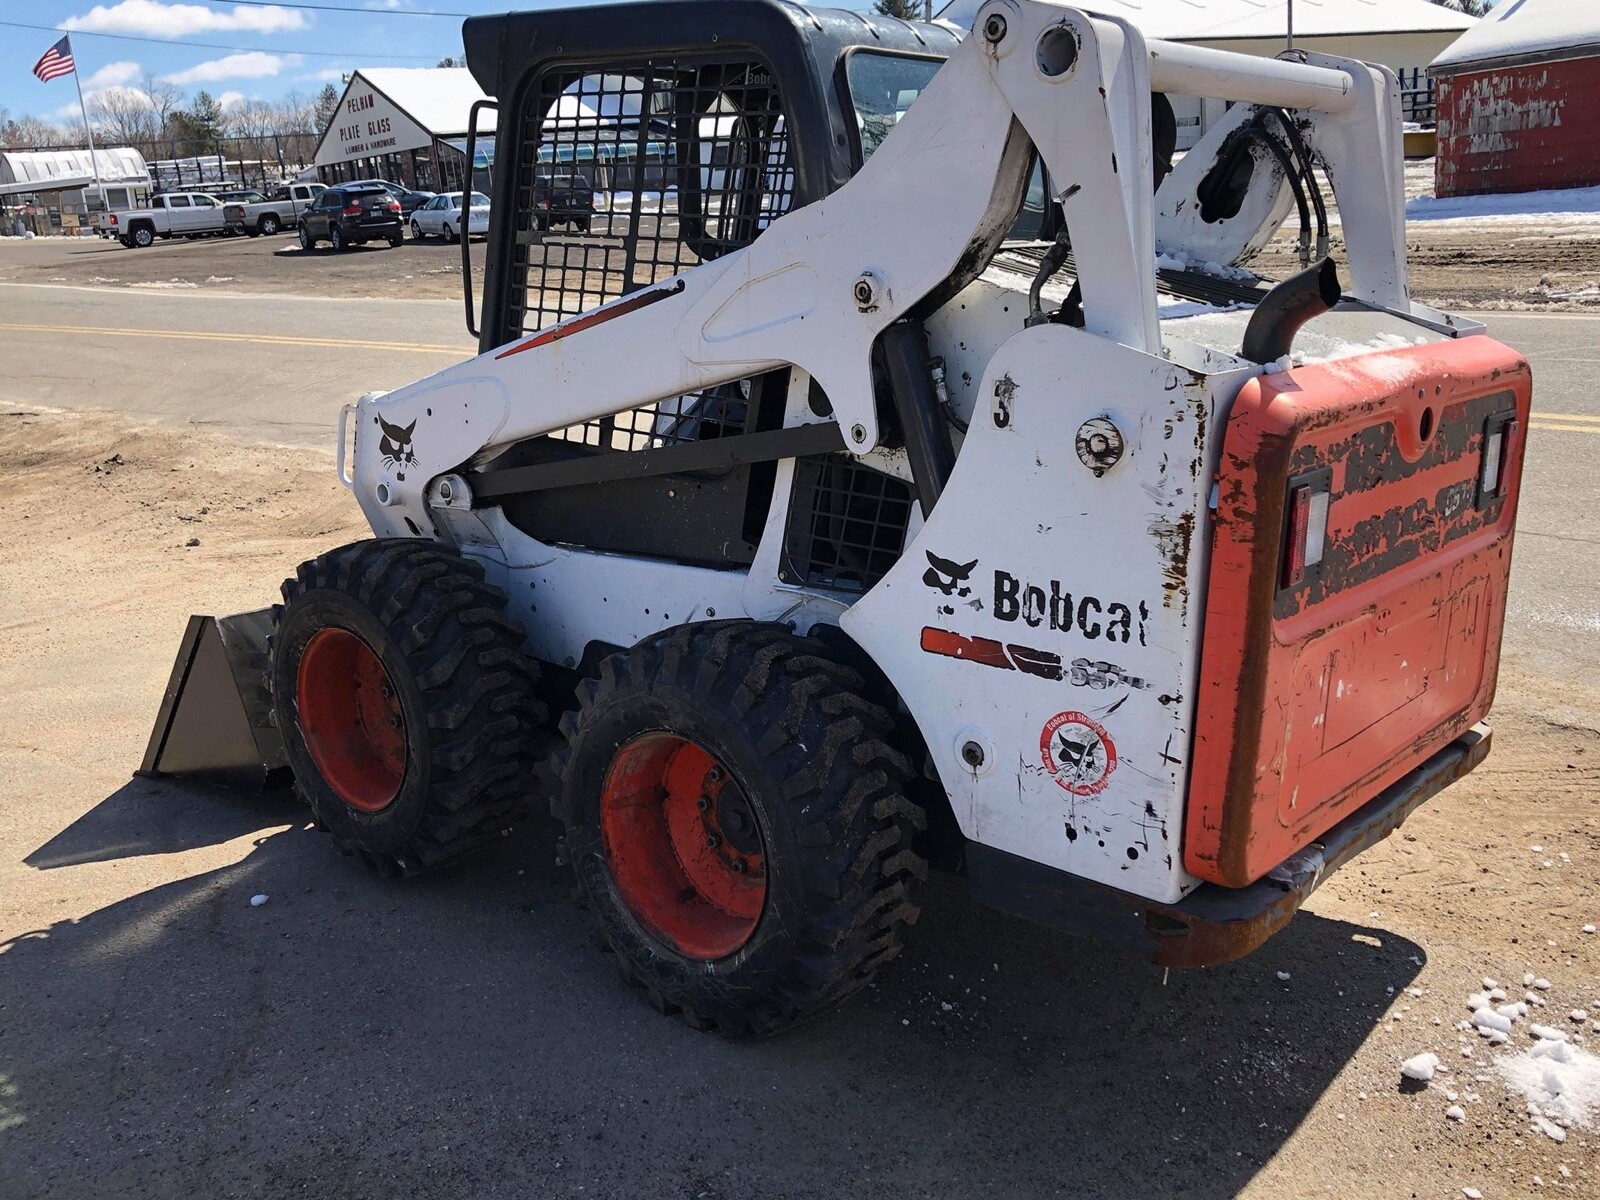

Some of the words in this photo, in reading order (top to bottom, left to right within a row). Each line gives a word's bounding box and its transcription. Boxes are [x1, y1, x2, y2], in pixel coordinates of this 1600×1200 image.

[347, 93, 375, 114] PELHAM
[339, 124, 360, 142] PLATE
[367, 117, 391, 136] GLASS
[370, 136, 397, 150] HARDWARE
[1046, 713, 1068, 731] Bobcat
